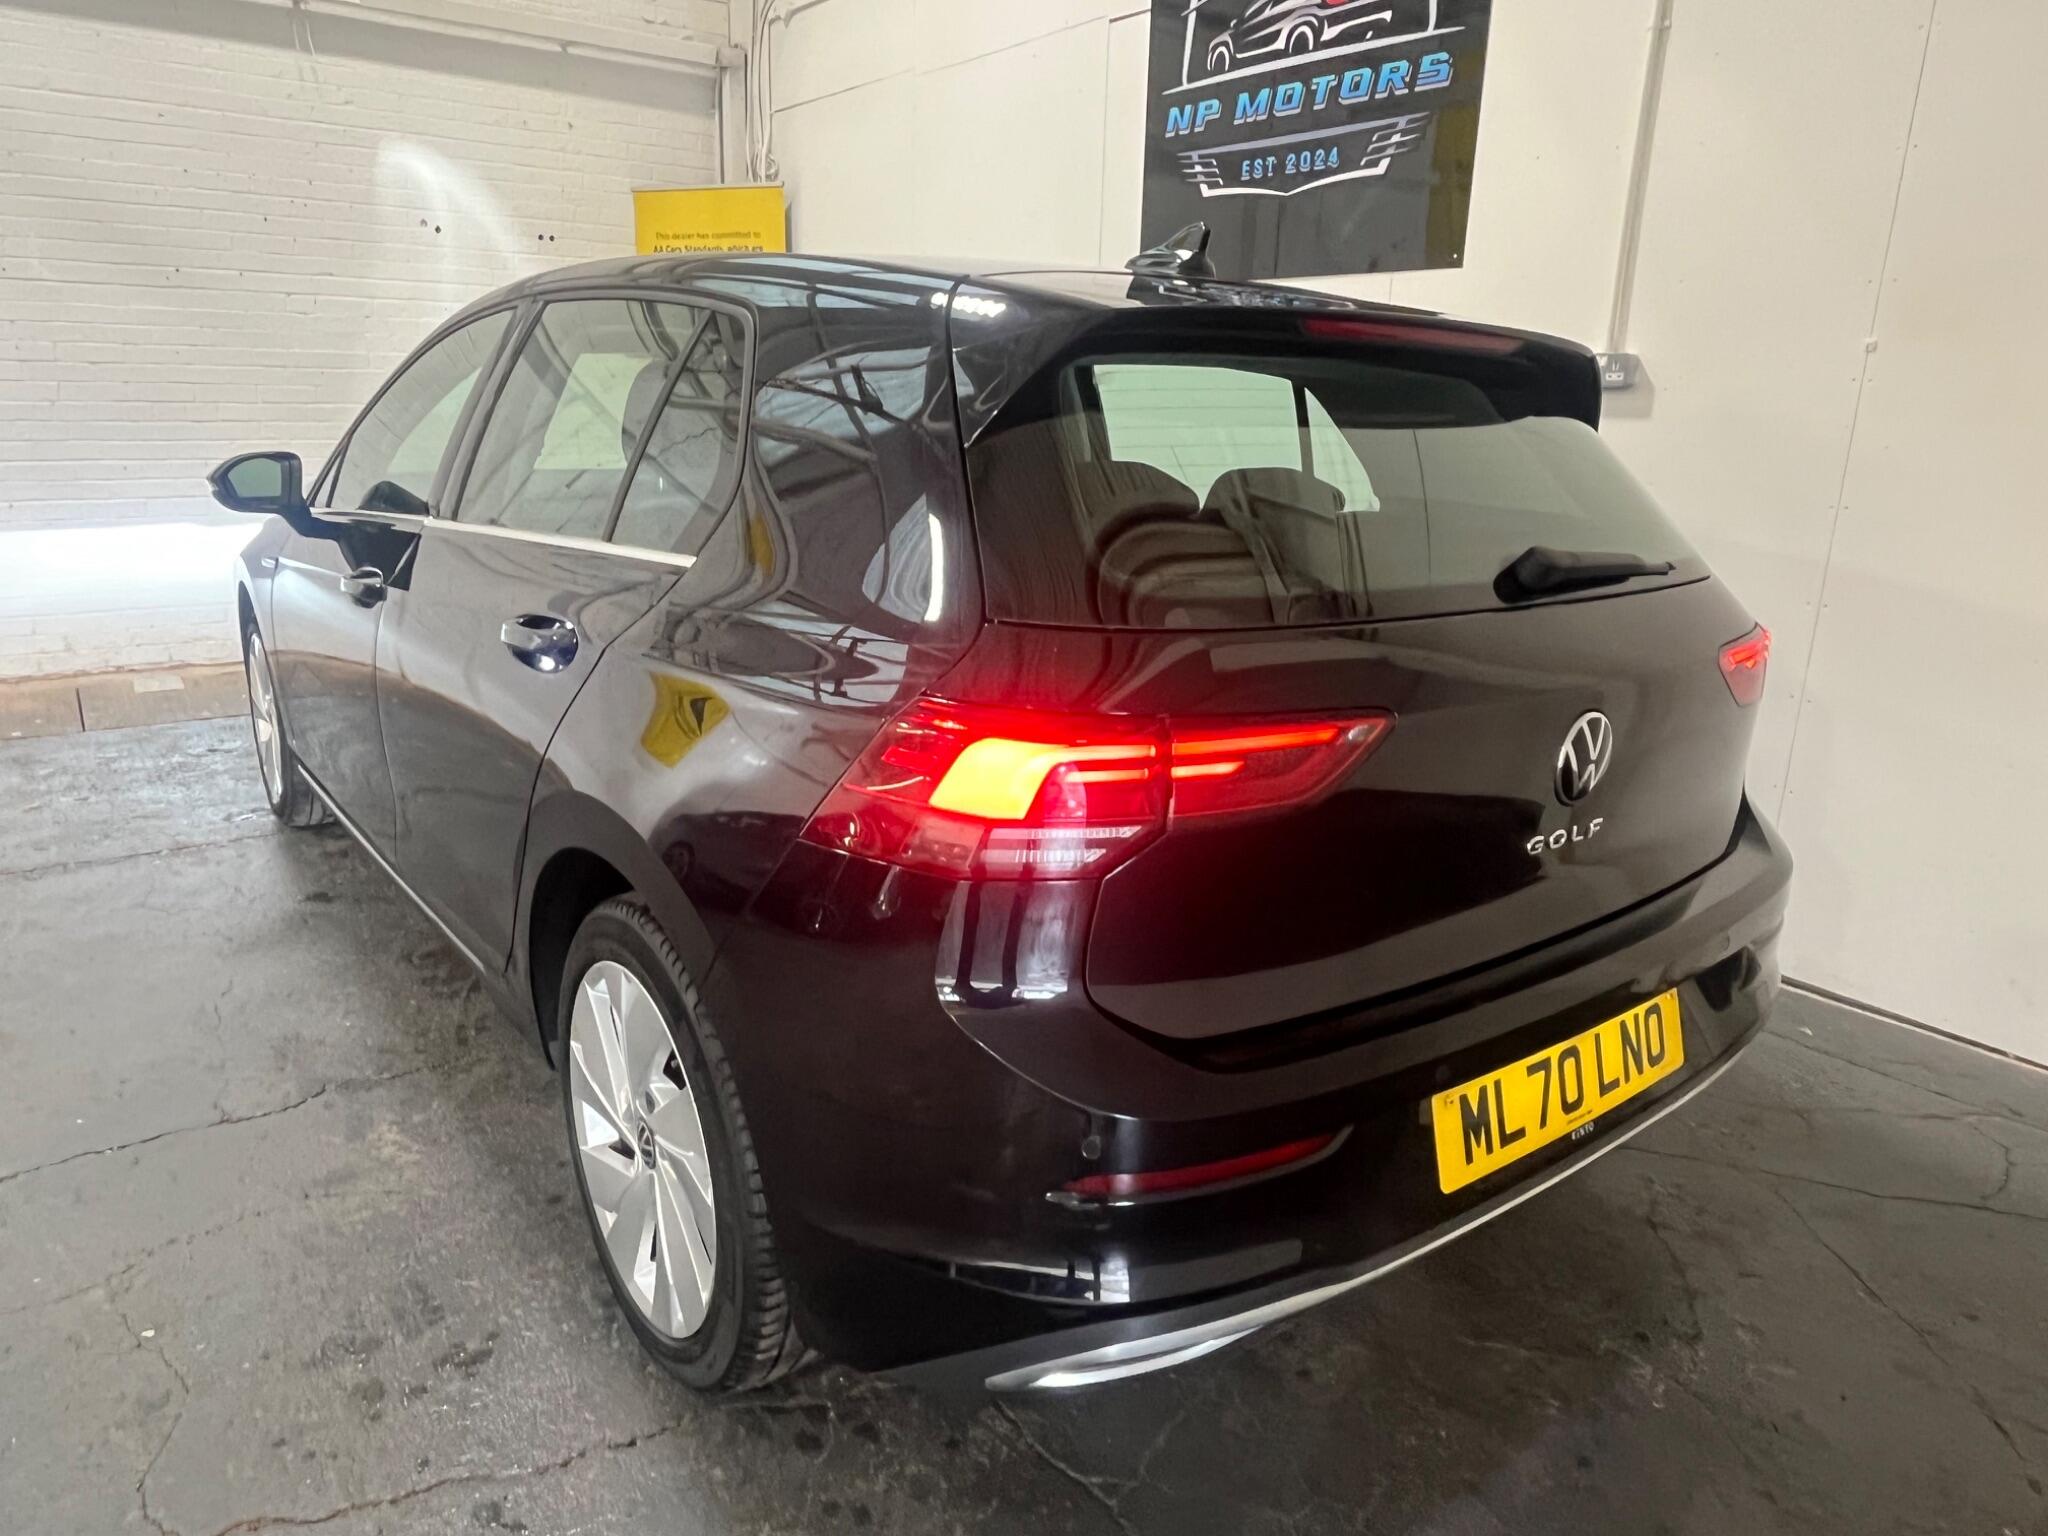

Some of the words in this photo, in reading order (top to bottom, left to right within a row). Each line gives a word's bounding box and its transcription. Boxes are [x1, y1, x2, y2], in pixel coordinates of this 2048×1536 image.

[1165, 98, 1222, 138] NP
[1233, 51, 1455, 125] MOTORS
[1240, 156, 1277, 181] EST
[1285, 146, 1341, 175] 2024
[655, 232, 670, 240] This
[672, 232, 694, 240] dealer
[711, 231, 751, 239] committed
[1526, 817, 1604, 855] GOLF
[1459, 1078, 1527, 1166] ML
[1526, 1044, 1584, 1130] 70
